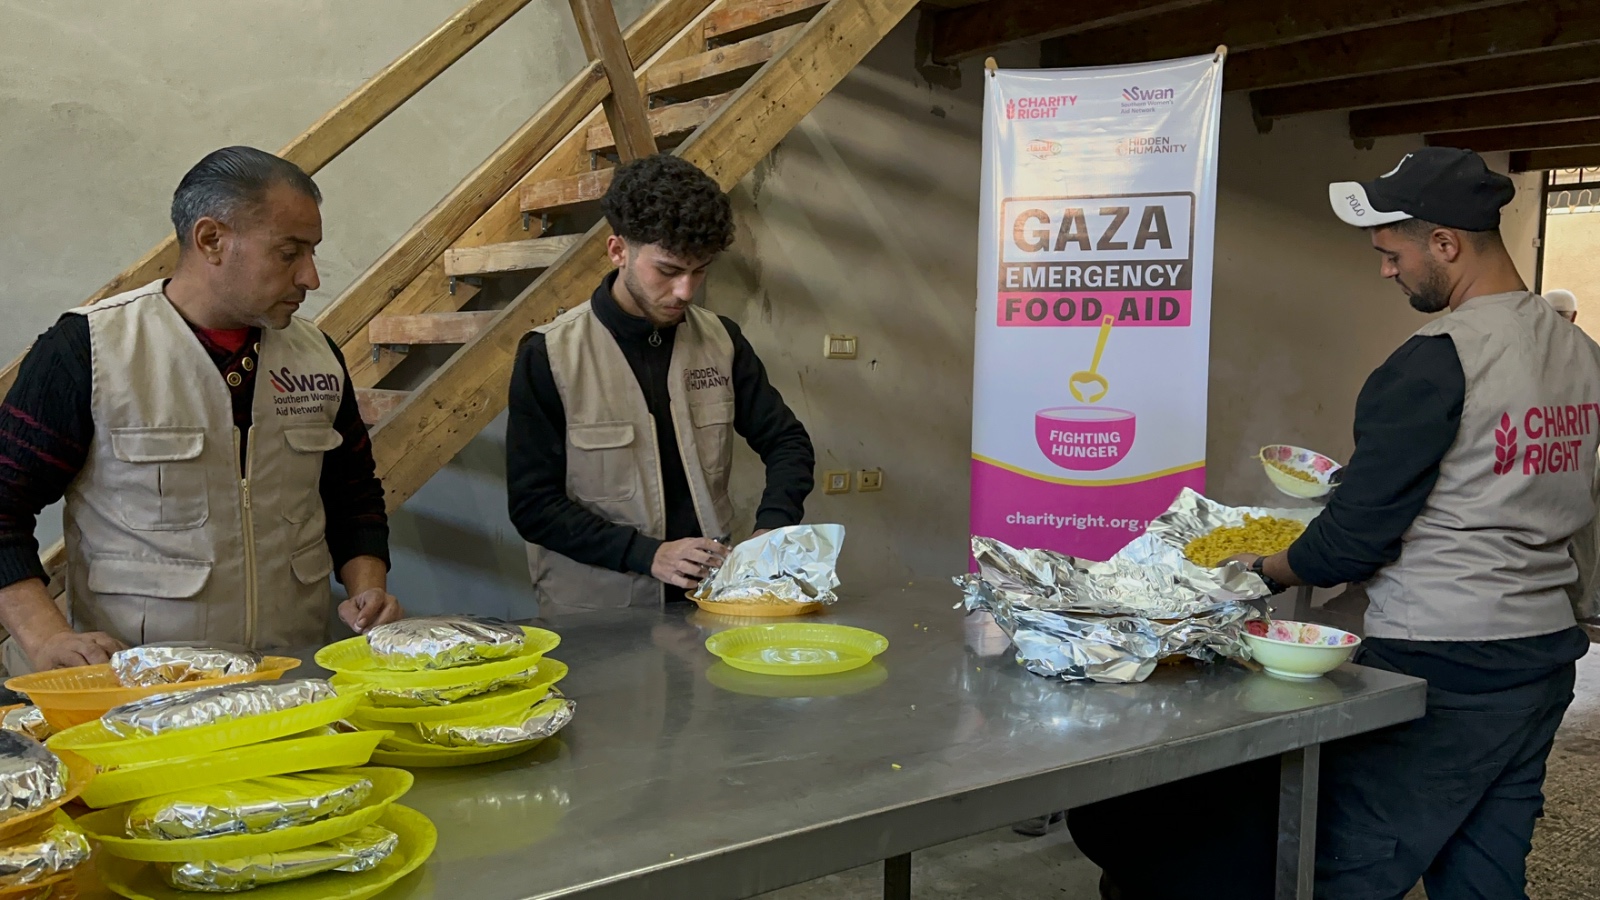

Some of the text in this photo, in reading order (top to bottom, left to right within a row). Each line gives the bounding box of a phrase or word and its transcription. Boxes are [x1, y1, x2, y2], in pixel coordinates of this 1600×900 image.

[1122, 86, 1174, 101] Swan
[1018, 95, 1078, 108] CHARITY
[1017, 107, 1058, 119] RIGHT
[1128, 137, 1170, 146] HIDDEN
[1128, 144, 1187, 155] HUMANITY
[1345, 194, 1366, 217] POLO
[1013, 205, 1173, 253] GAZA
[1005, 264, 1183, 288] EMERGENCY
[1005, 297, 1180, 322] FOOD AID
[269, 367, 340, 393] Swan
[273, 393, 309, 404] Southern
[276, 404, 324, 416] Aid Network
[1049, 430, 1121, 444] FIGHTING
[1051, 444, 1118, 458] HUNGER
[1523, 440, 1582, 475] RIGHT
